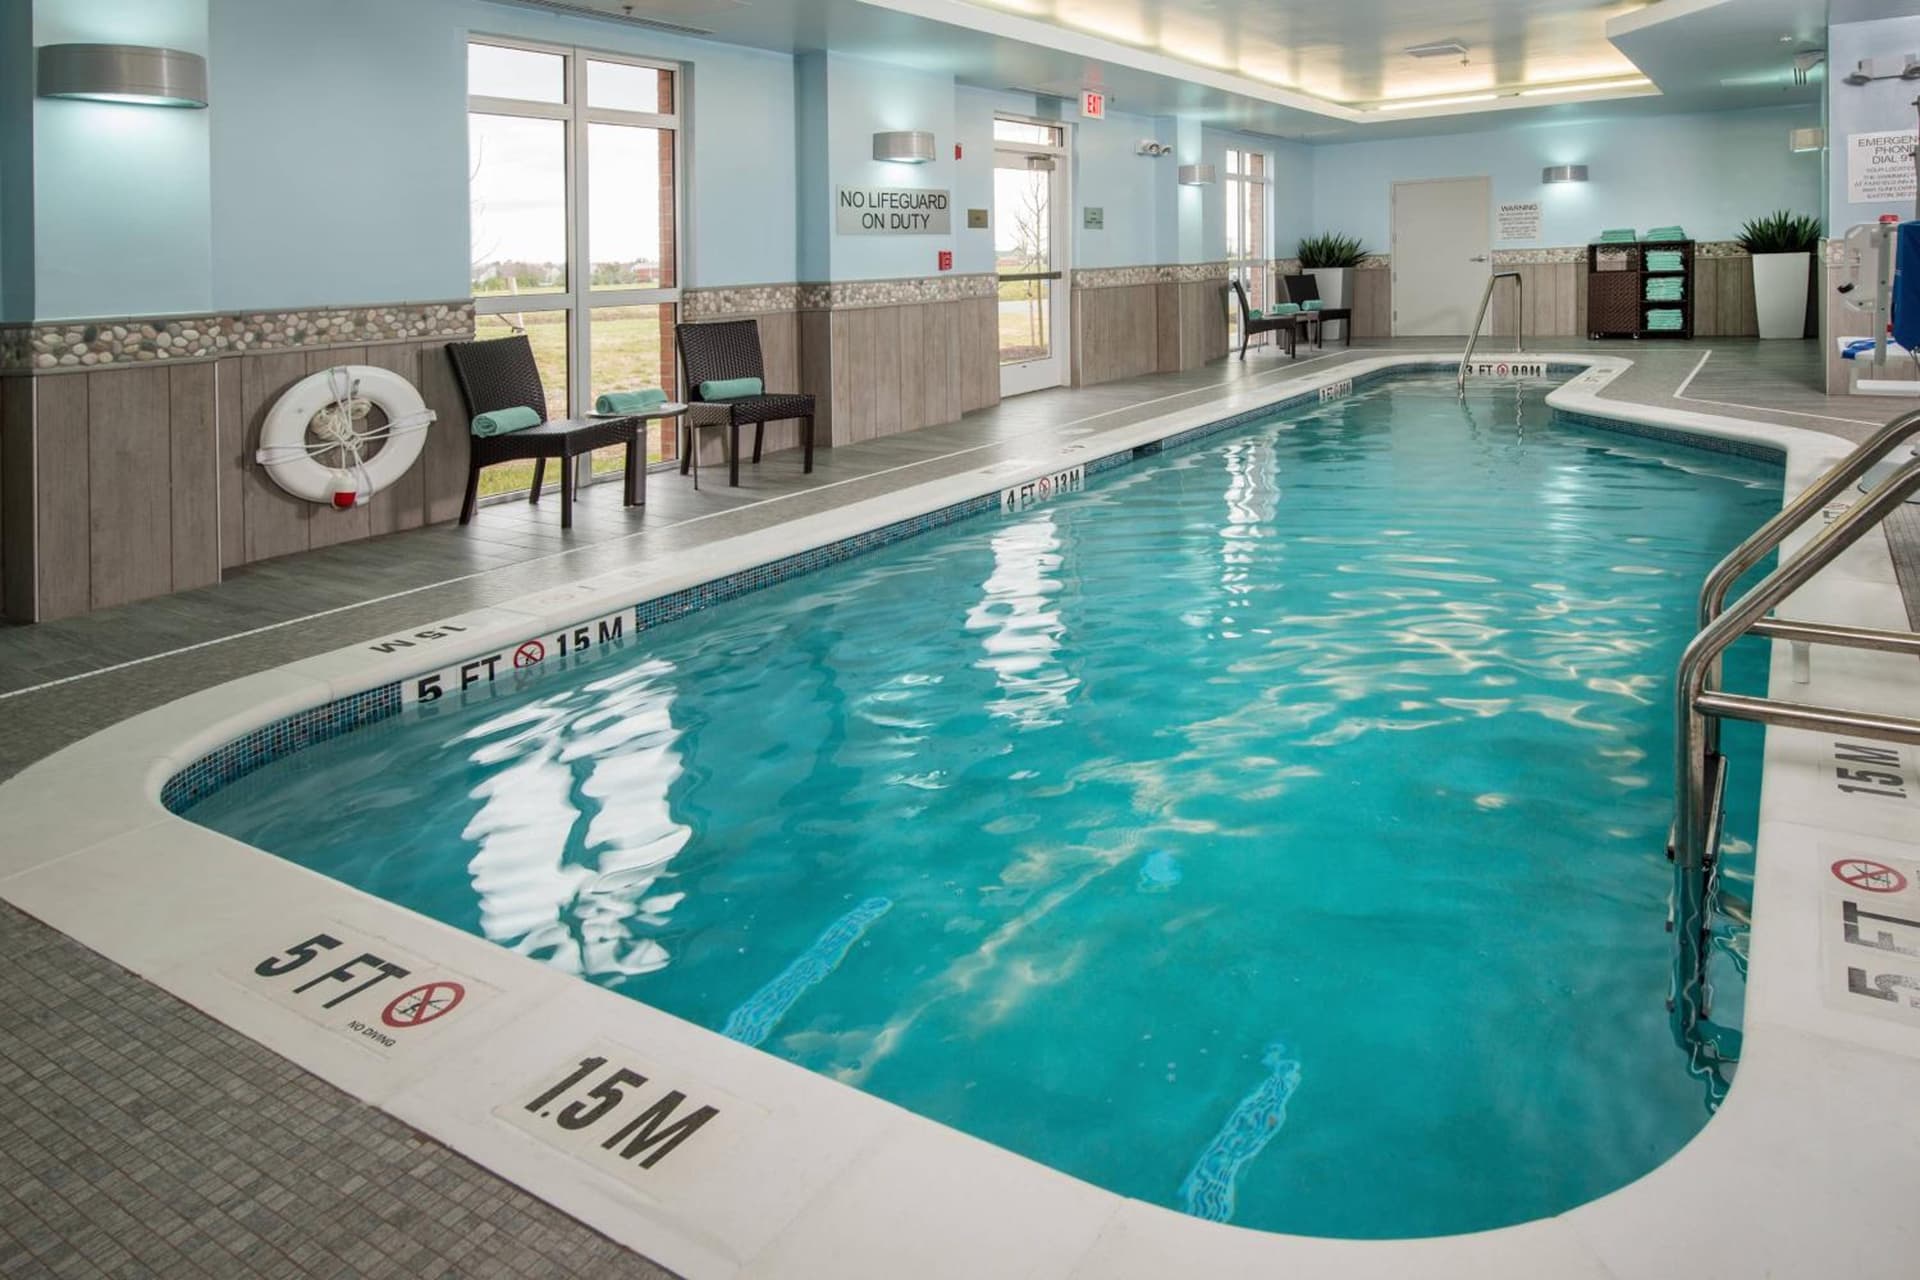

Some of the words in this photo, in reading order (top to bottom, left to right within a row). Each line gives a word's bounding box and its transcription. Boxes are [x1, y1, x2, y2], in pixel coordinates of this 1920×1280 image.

[1858, 135, 1918, 147] EMERGEN
[1872, 155, 1897, 164] DIAL
[840, 190, 865, 208] NO
[868, 191, 948, 210] LIFEGUARD
[1501, 204, 1538, 212] WARNING
[862, 212, 885, 230] ON
[890, 212, 931, 230] DUTY
[1479, 364, 1493, 376] FT
[1007, 489, 1014, 505] 4
[1021, 482, 1035, 500] FT
[418, 674, 443, 703] 5
[461, 654, 502, 690] FT
[254, 933, 343, 977] 5
[292, 952, 412, 1009] FT
[348, 1020, 366, 1032] NO
[361, 1027, 397, 1047] DIVING
